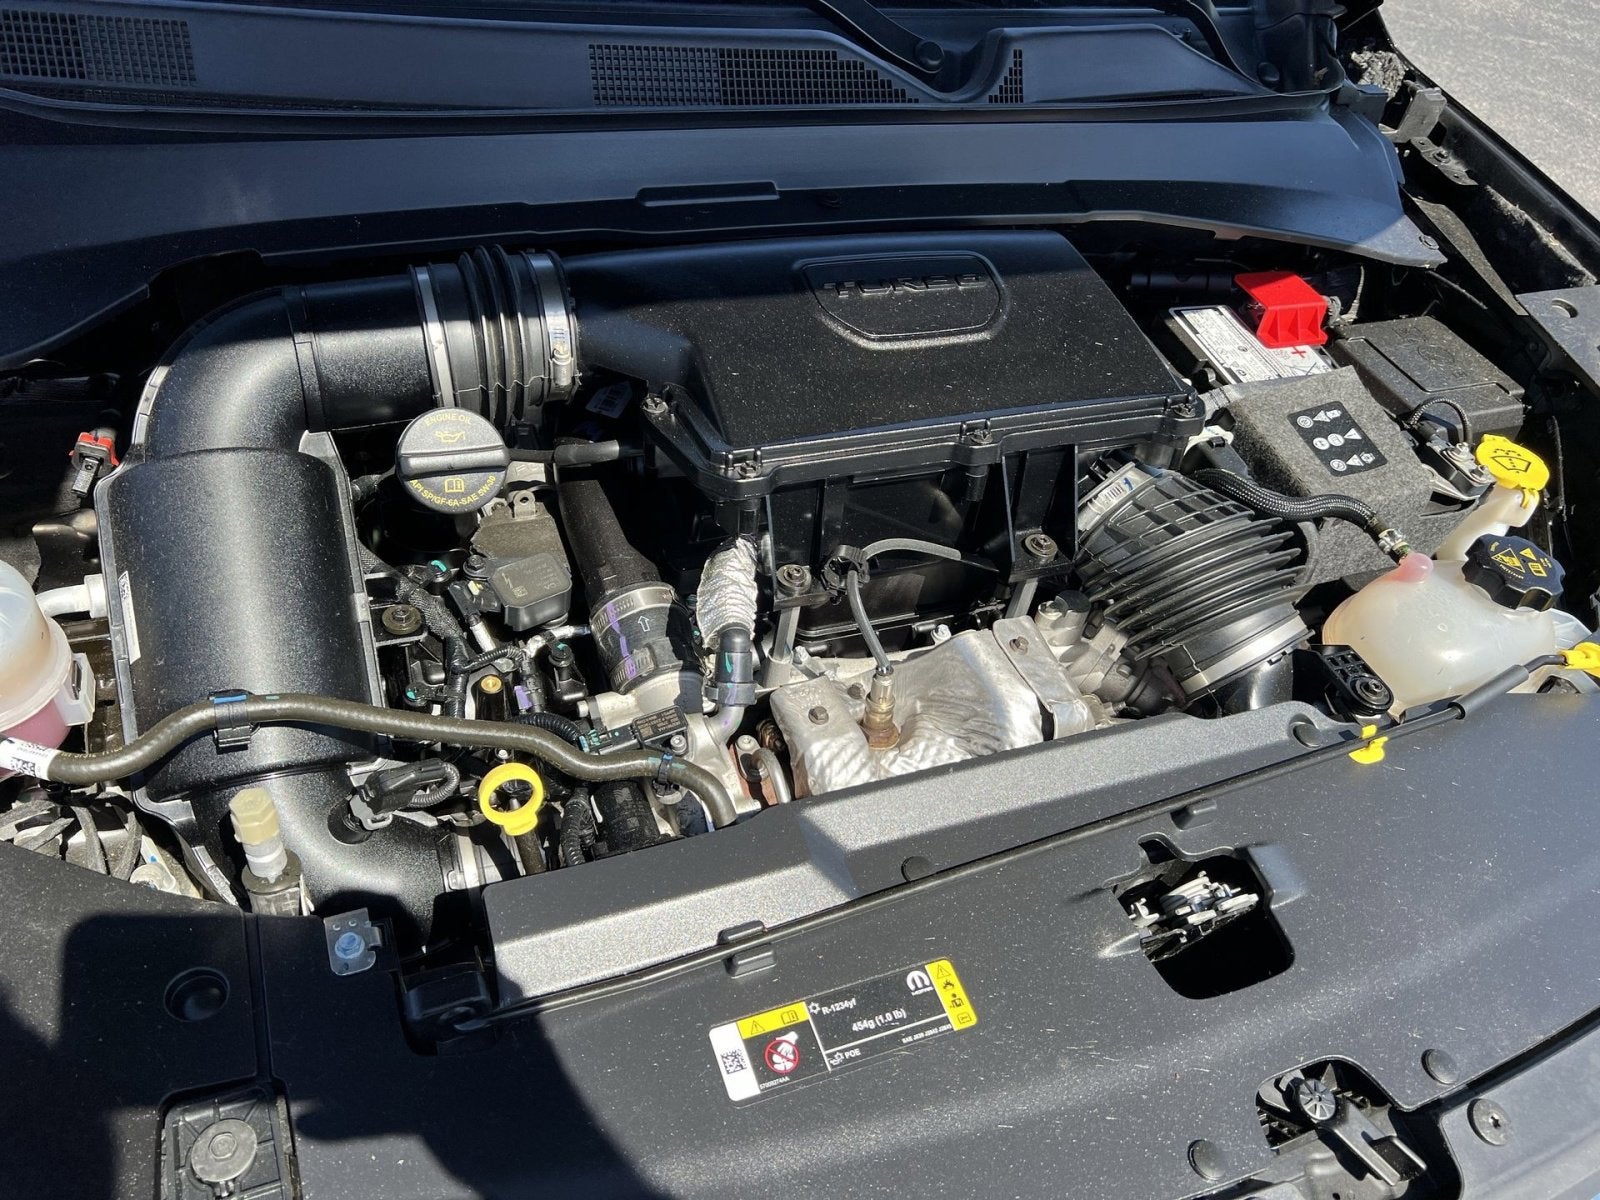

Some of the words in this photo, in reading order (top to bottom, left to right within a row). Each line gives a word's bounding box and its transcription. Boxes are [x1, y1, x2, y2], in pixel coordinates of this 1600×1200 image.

[425, 413, 458, 426] ENGINE
[459, 414, 471, 425] OIL
[410, 479, 424, 493] API
[822, 998, 857, 1015] R-1234yf
[851, 1019, 876, 1032] 454g
[874, 1012, 894, 1027] (1.0
[892, 1008, 907, 1020] lb)
[844, 1048, 861, 1059] POE
